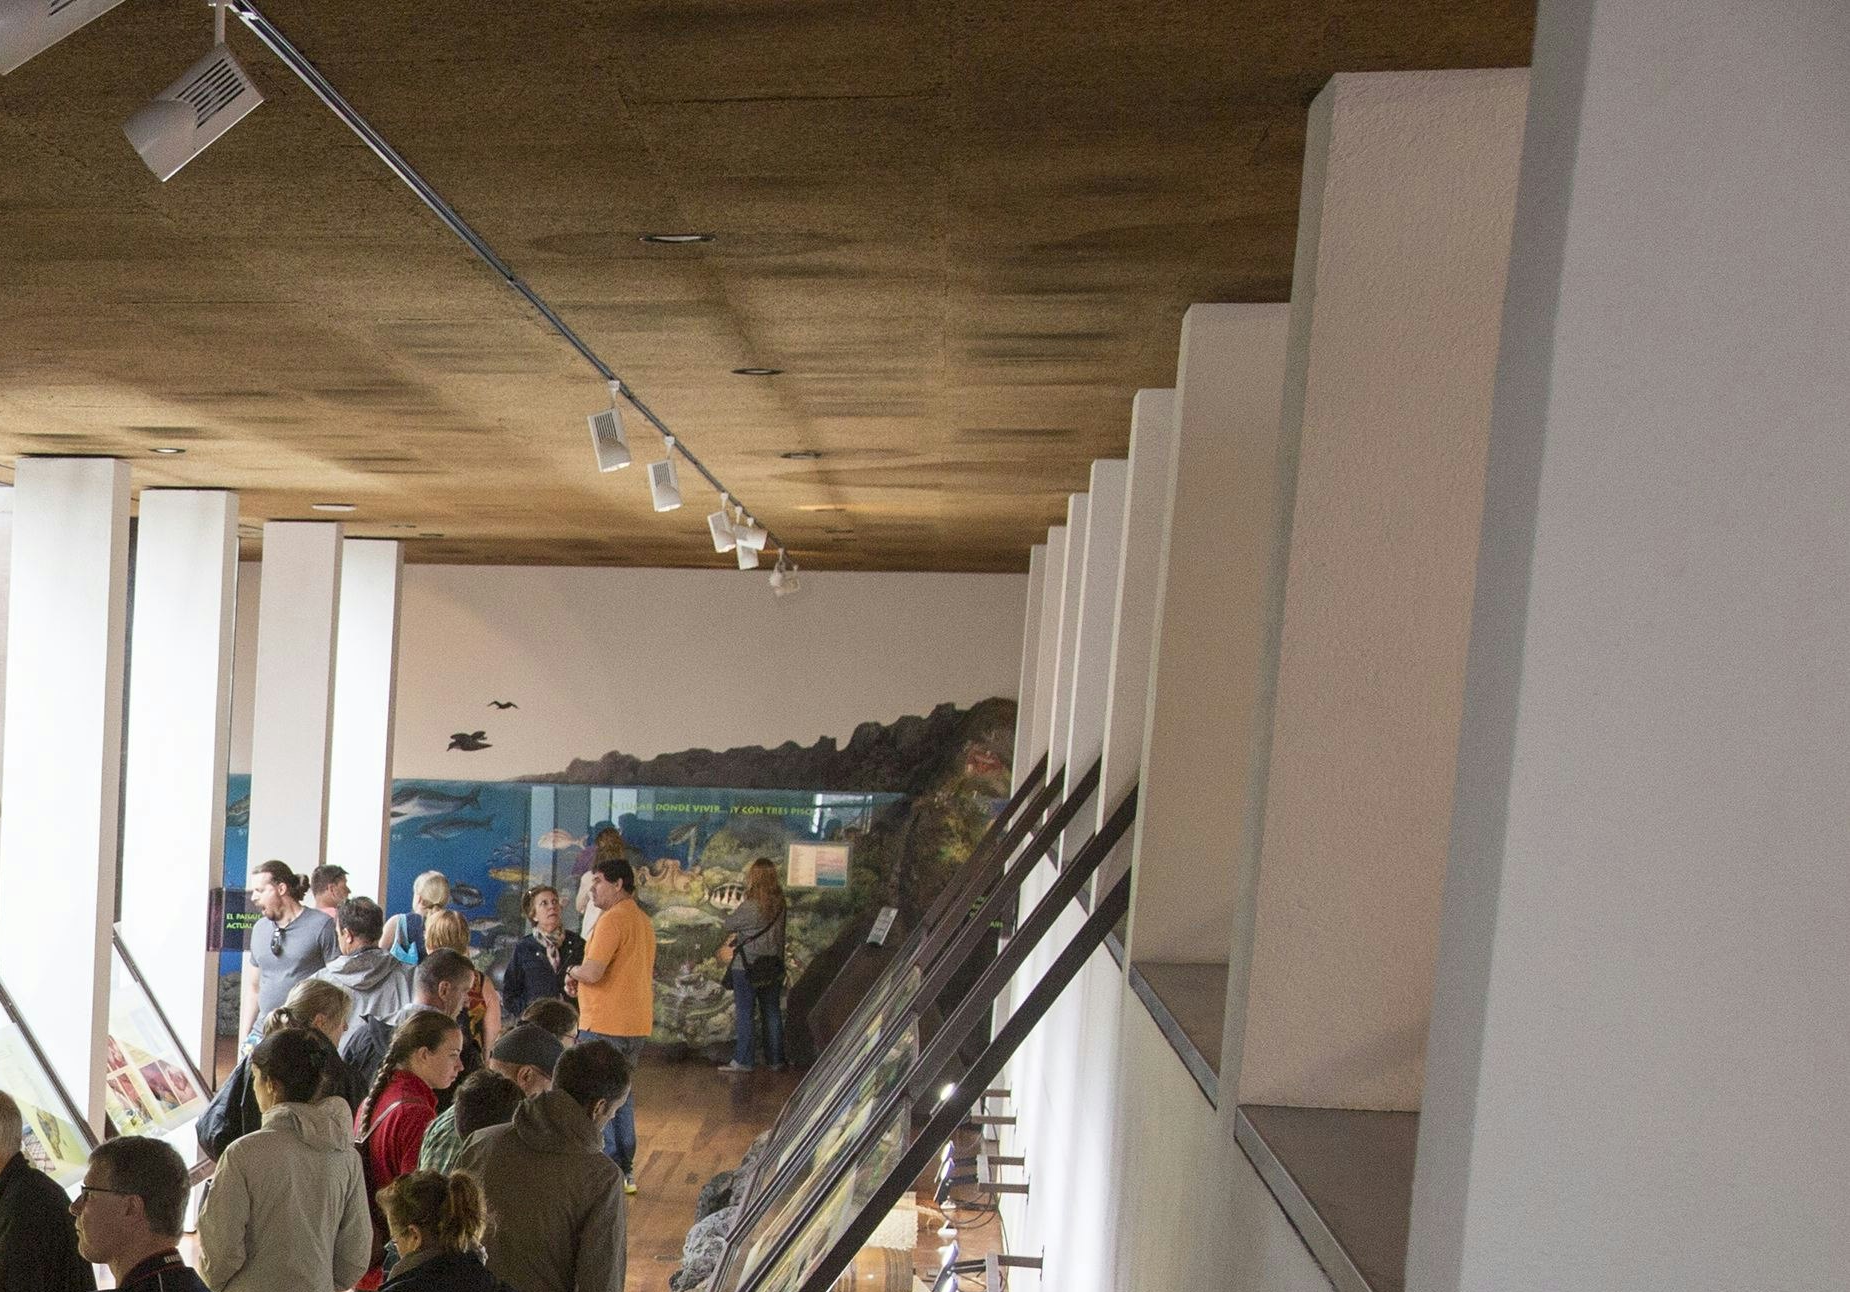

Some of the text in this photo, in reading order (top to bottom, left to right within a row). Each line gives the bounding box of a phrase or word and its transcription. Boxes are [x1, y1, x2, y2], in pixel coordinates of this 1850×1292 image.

[656, 804, 691, 812] DONDE
[742, 806, 763, 814] CON
[765, 806, 788, 815] TRES
